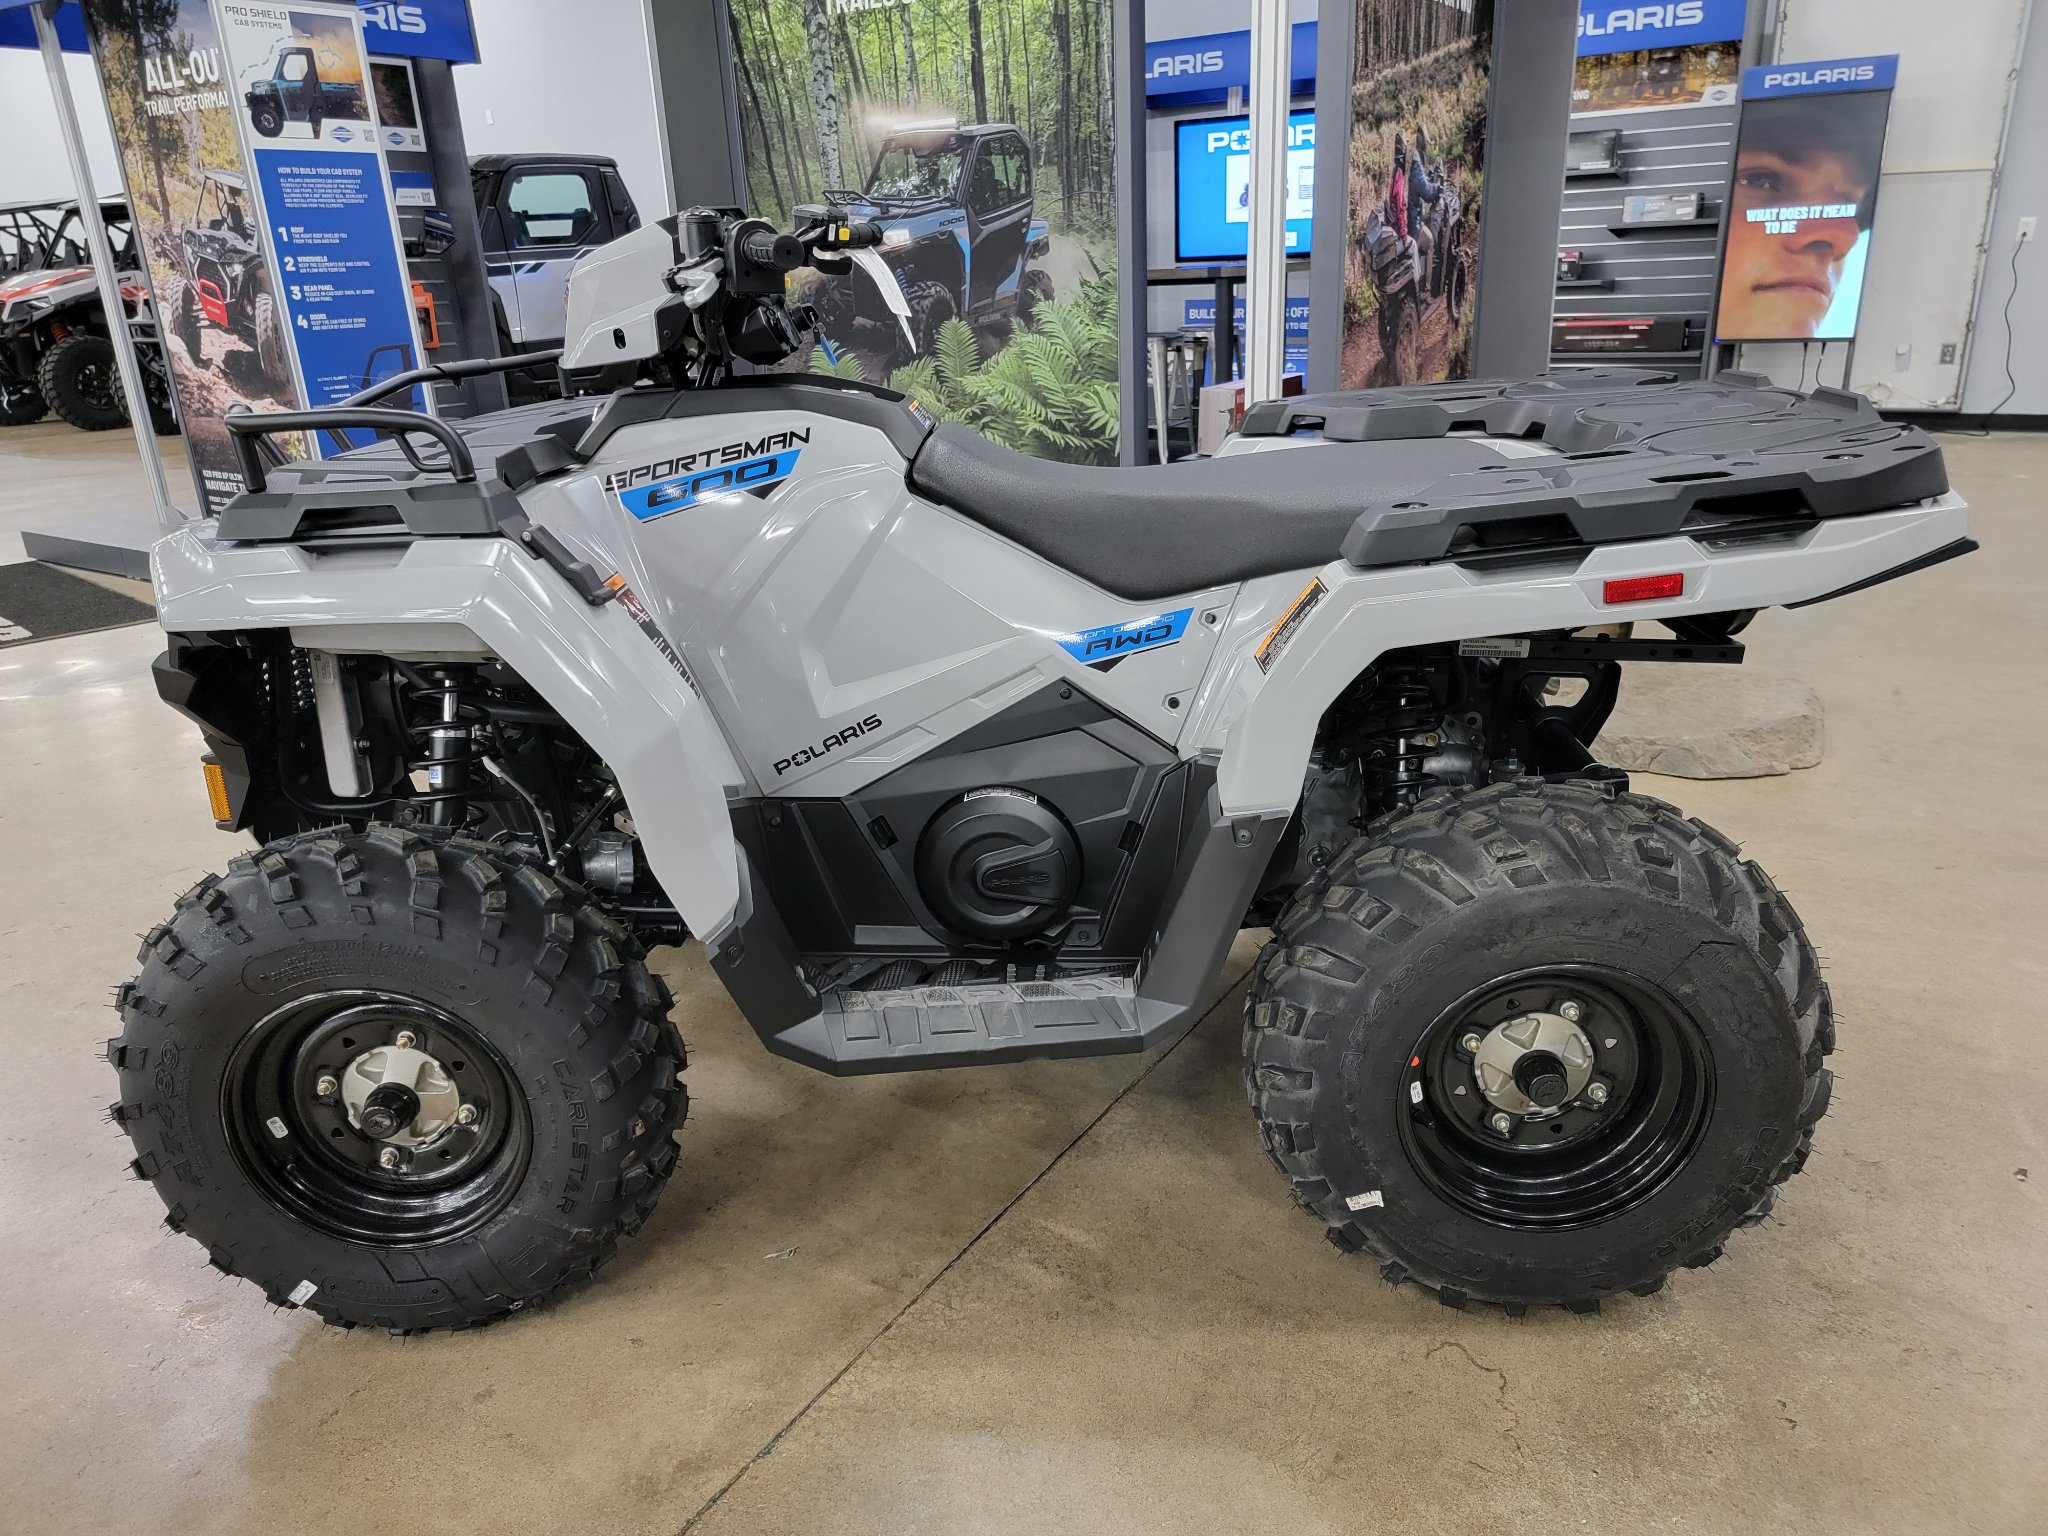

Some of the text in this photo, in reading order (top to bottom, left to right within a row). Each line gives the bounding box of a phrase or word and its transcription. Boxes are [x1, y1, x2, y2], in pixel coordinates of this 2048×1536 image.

[224, 6, 287, 20] PRO SHIELD
[234, 18, 282, 30] CAB SYSTEMS
[144, 48, 218, 92] ALL-OU
[1764, 66, 1874, 88] POLARIS
[144, 90, 229, 116] TRAIL PERFORMA
[1208, 124, 1315, 153] POR
[300, 167, 316, 175] BUILD
[316, 167, 331, 175] YOUR
[343, 168, 363, 176] SYSTEM
[1746, 204, 1856, 222] WHAT DOES IT MEAN
[938, 216, 966, 228] 1000
[1764, 221, 1797, 234] TO BE
[278, 226, 288, 242] 1
[284, 256, 296, 271] 2
[290, 286, 301, 300] 3
[297, 314, 308, 329] 4
[1233, 308, 1245, 318] UR
[605, 427, 810, 492] SPORTSMAN
[205, 480, 239, 492] NAVIGATE
[648, 458, 778, 508] 600
[1113, 615, 1174, 633] DEND
[1085, 624, 1172, 655] AWD
[773, 714, 882, 776] POLARIS
[552, 1058, 591, 1215] CARLSTAR
